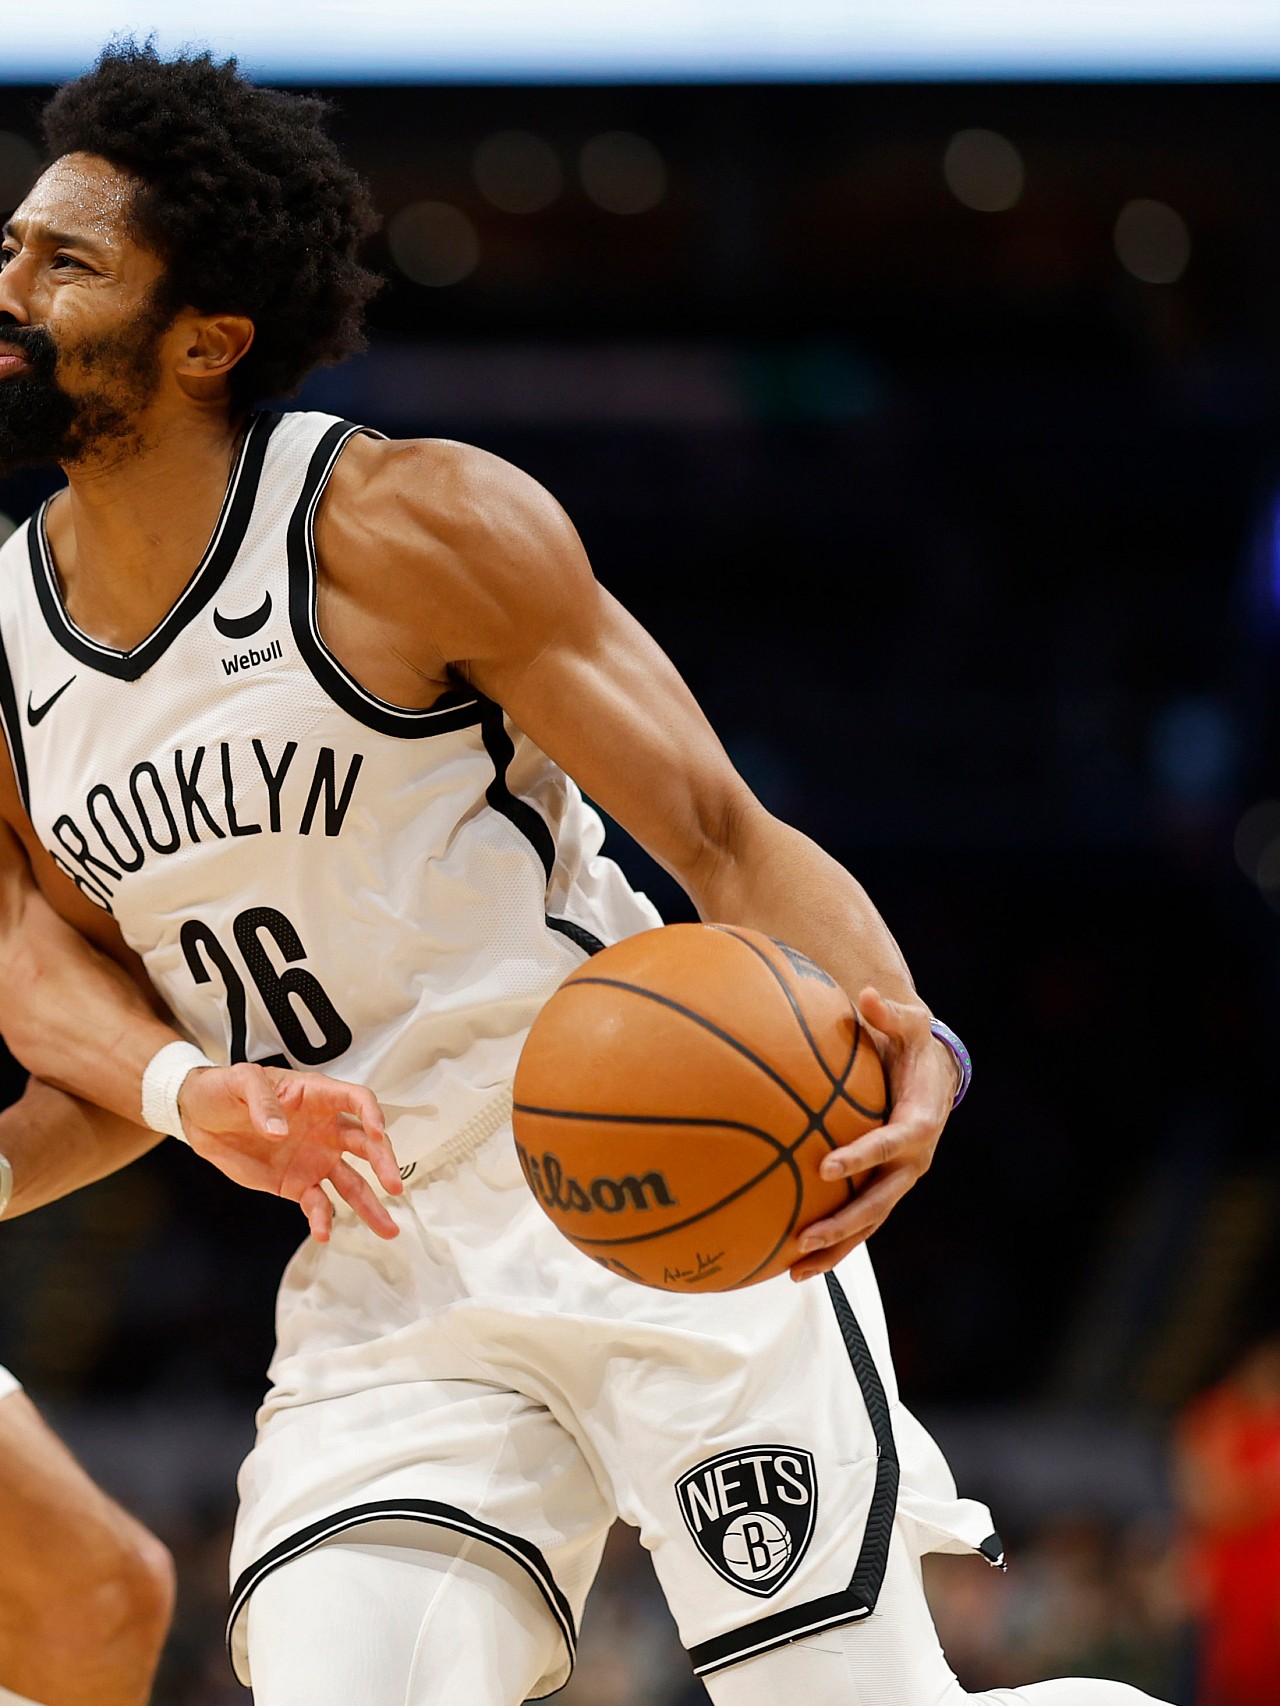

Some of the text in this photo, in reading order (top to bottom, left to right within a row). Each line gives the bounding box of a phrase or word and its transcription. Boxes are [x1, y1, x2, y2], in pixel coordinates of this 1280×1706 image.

[221, 639, 283, 676] Webull
[179, 906, 353, 1070] 26
[685, 1455, 809, 1533] NETS
[741, 1520, 772, 1573] B
